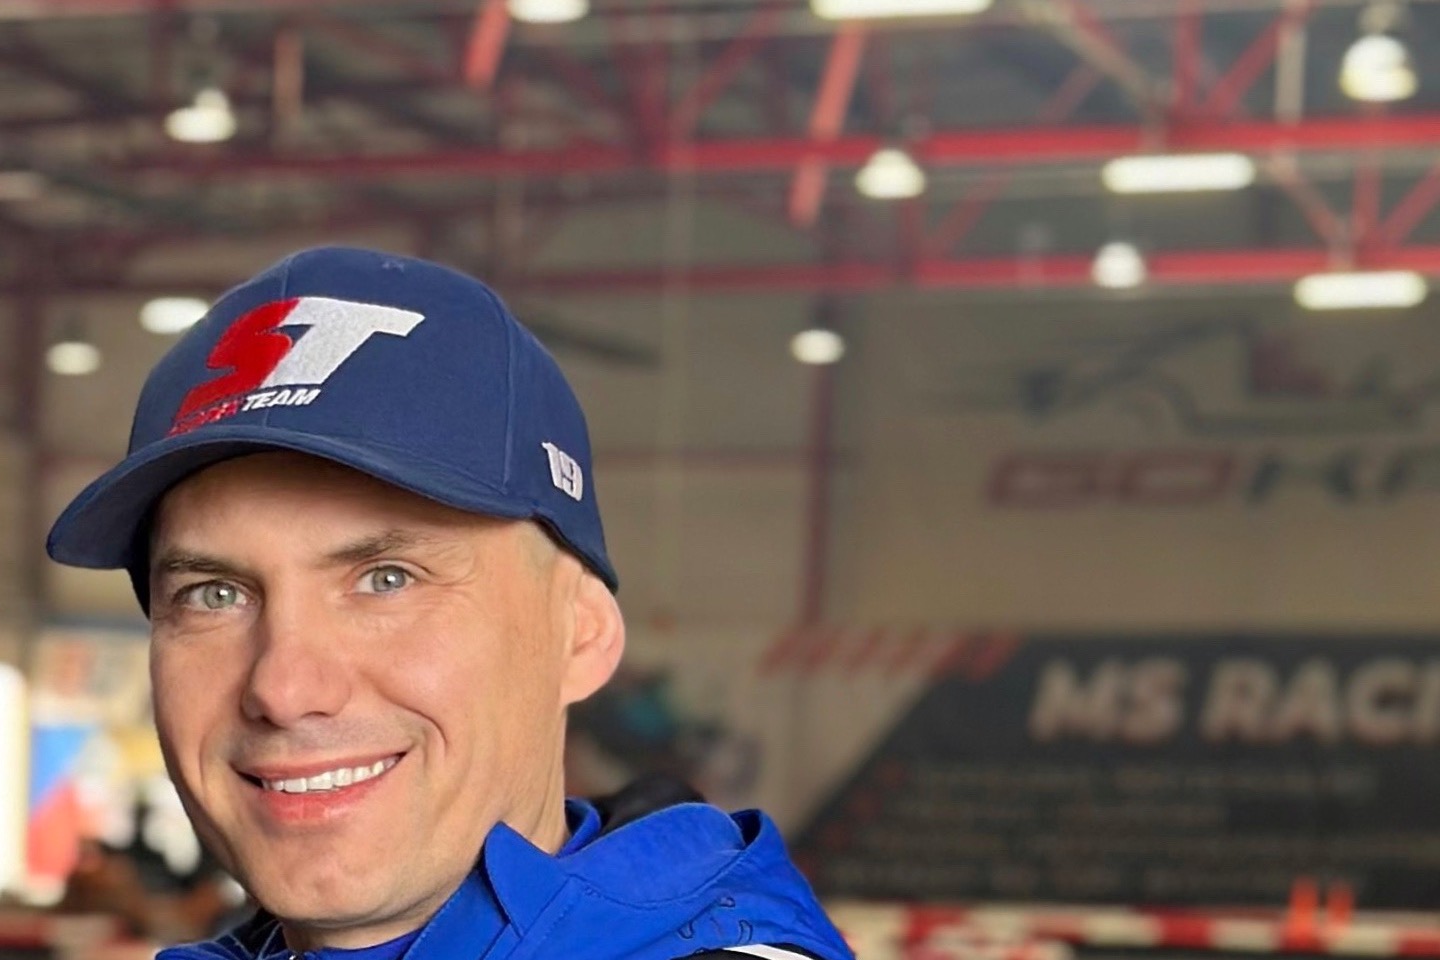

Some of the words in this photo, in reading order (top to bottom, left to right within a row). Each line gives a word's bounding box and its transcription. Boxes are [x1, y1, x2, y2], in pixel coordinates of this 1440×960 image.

[176, 296, 426, 424] ST
[242, 388, 321, 412] TEAM
[542, 441, 583, 501] 19
[1026, 655, 1188, 743] MS
